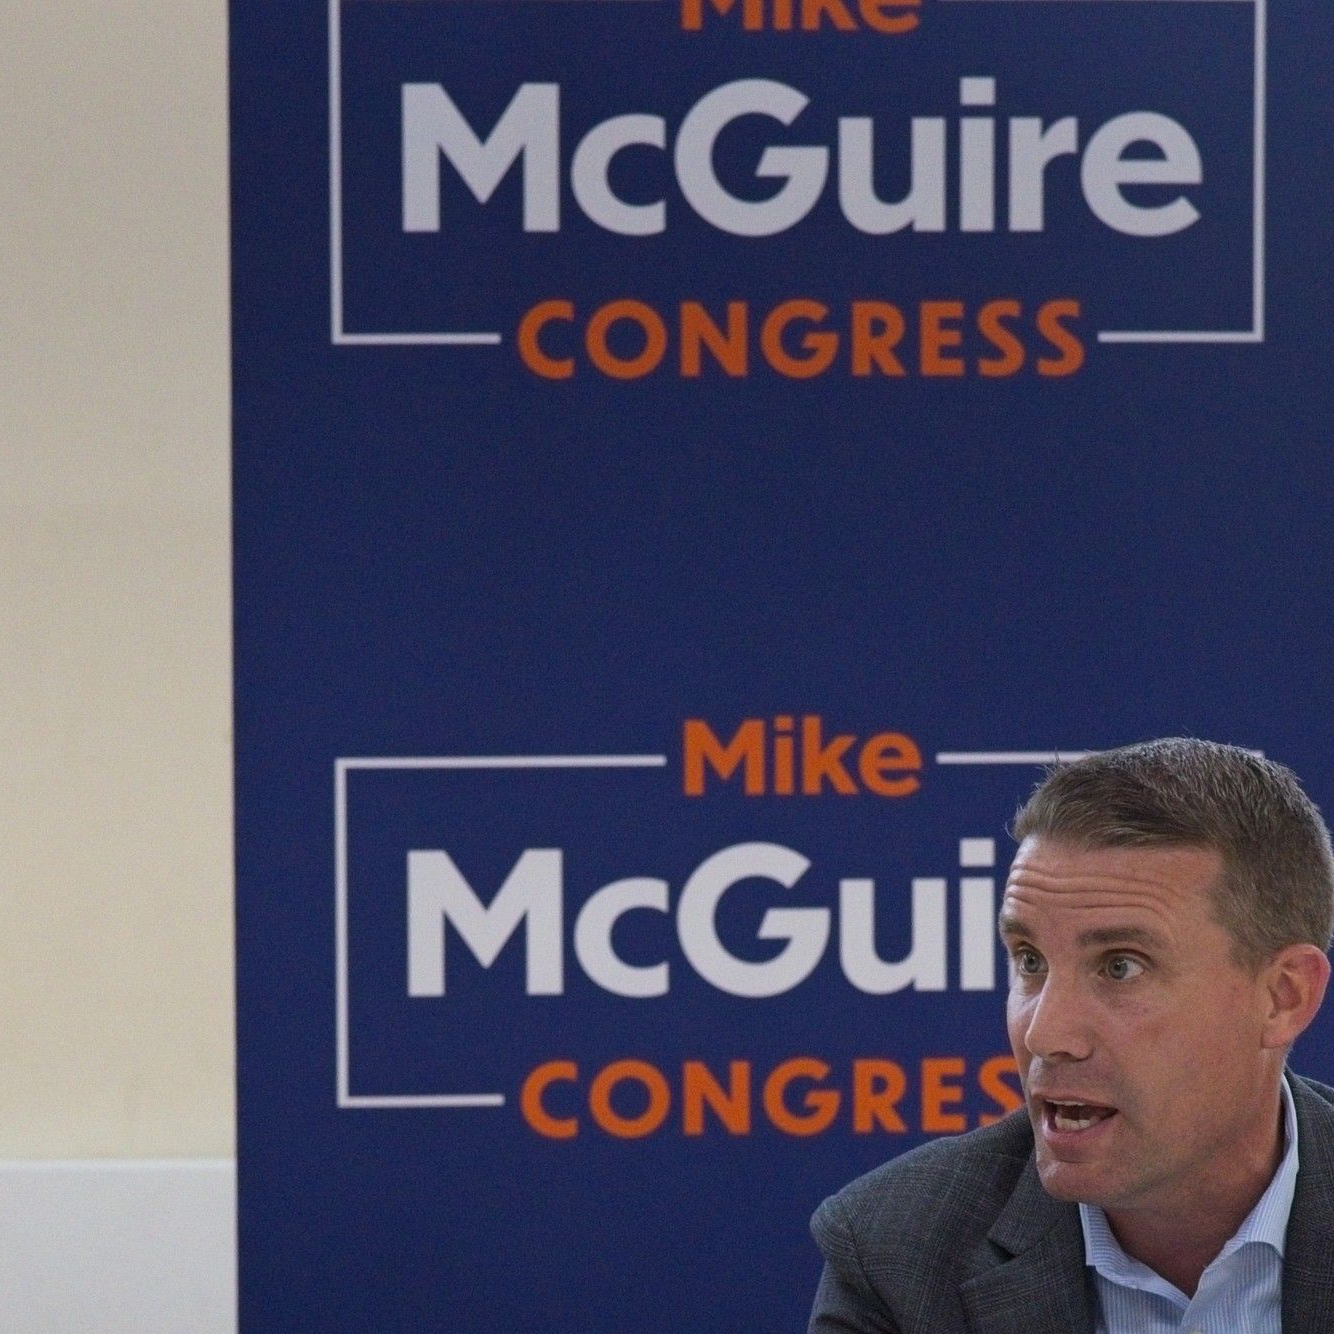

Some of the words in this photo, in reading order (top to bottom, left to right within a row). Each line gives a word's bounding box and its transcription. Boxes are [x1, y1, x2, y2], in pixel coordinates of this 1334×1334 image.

[402, 77, 1204, 236] McGuire
[517, 299, 1085, 379] CONGRESS
[683, 715, 921, 797] Mike
[406, 838, 995, 999] McGui
[520, 1056, 1023, 1139] CONGRES
